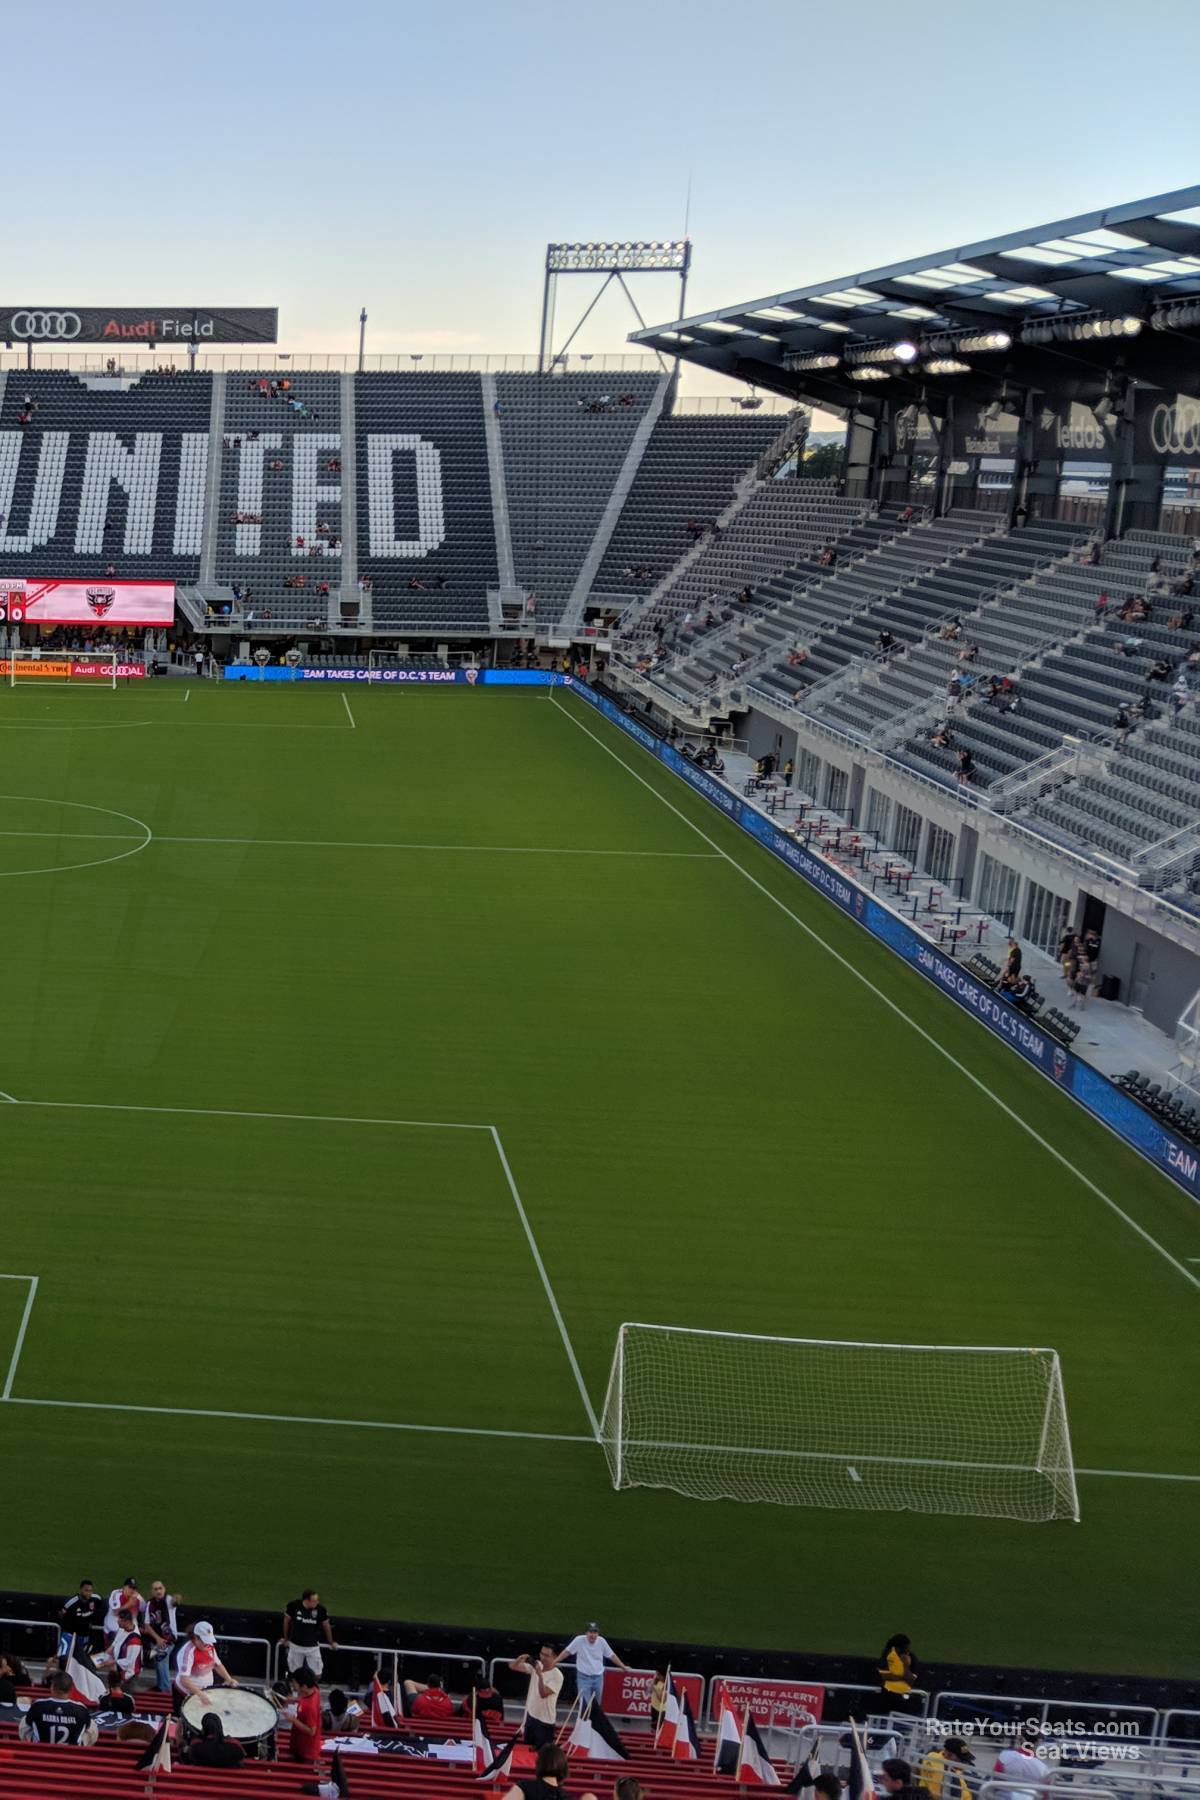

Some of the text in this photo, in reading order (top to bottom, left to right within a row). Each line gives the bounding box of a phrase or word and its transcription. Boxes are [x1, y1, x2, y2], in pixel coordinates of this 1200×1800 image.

[103, 320, 214, 337] Audi Field
[1057, 414, 1105, 449] leidos
[12, 607, 23, 620] 0
[74, 665, 95, 674] Audi
[327, 670, 355, 679] TAKES
[357, 670, 382, 680] CARE
[383, 671, 398, 680] OF
[428, 672, 456, 681] TEAM
[800, 853, 813, 875] CARE
[812, 864, 822, 879] OF
[835, 882, 852, 904] TEAM
[934, 957, 956, 989] TAKES
[956, 975, 979, 1007] CARE
[979, 995, 993, 1015] OF
[1017, 1024, 1045, 1058] TEAM
[1162, 1136, 1198, 1181] TEAM
[623, 1676, 654, 1688] SMO
[622, 1688, 653, 1700] DEV
[762, 1690, 777, 1698] BE
[779, 1691, 818, 1705] ALERT!
[627, 1702, 653, 1713] AR
[752, 1697, 774, 1707] MAY
[740, 1704, 769, 1715] FELD
[49, 1725, 70, 1745] 12
